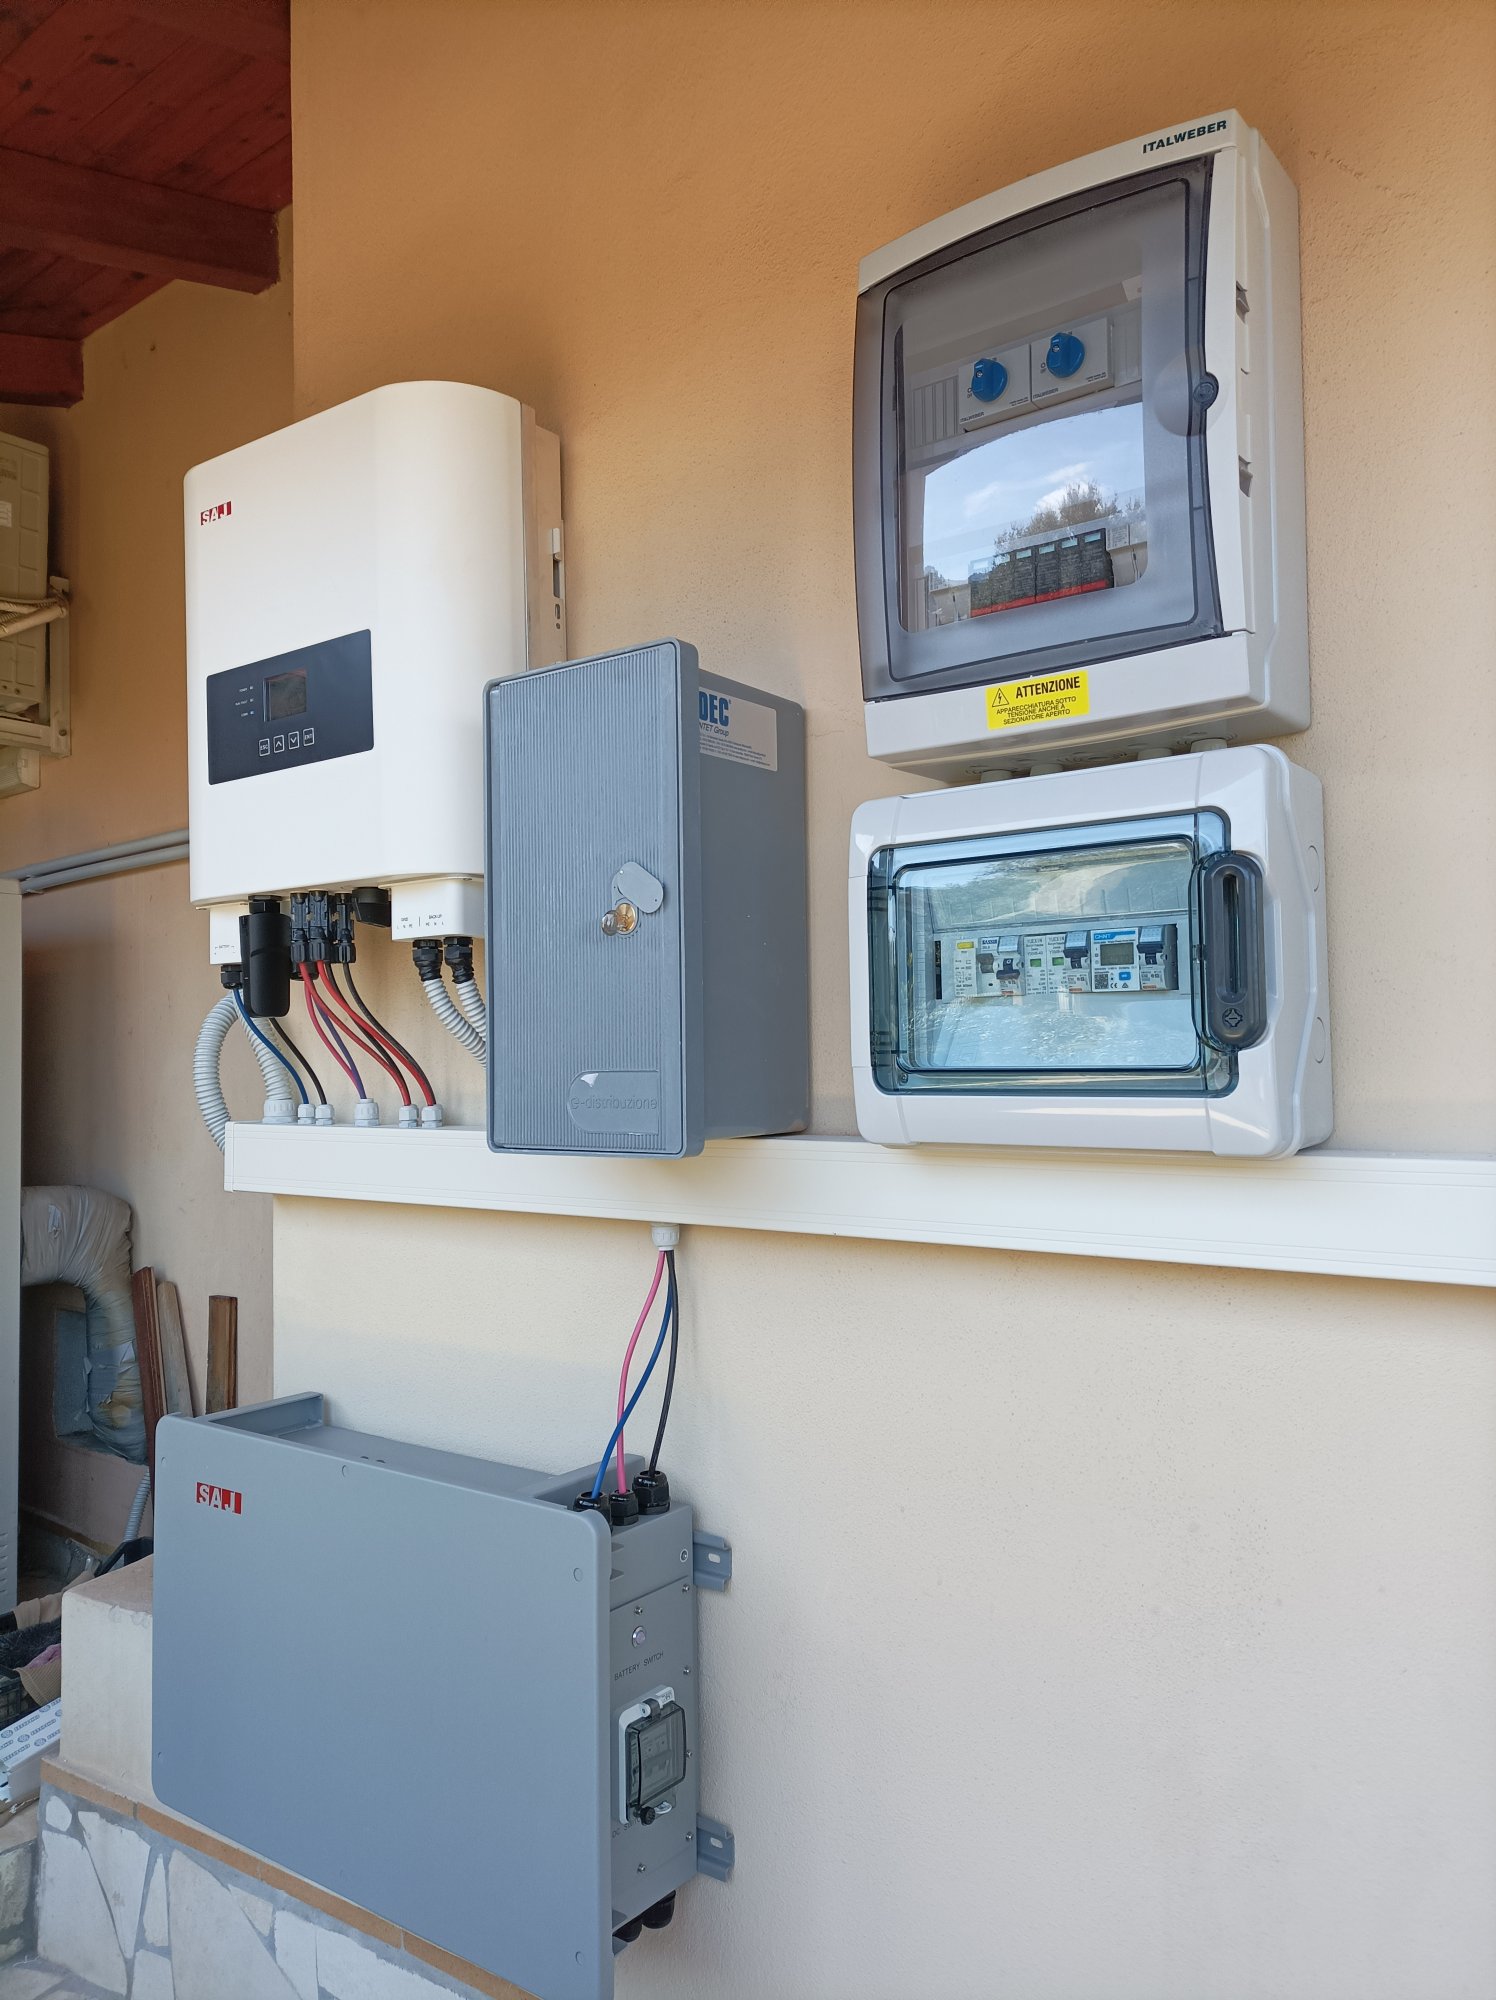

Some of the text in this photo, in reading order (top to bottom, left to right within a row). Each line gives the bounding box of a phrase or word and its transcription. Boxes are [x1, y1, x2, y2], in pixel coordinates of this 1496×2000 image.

[1143, 120, 1227, 154] ITALWEBER
[200, 501, 232, 526] SAJ
[1016, 676, 1080, 699] ATTENZIONE
[996, 696, 1077, 715] APPARECCHIATURA SOTTO
[1003, 709, 1071, 725] SEZIONATORE APERTO
[1007, 708, 1038, 718] TENSIONE
[1039, 704, 1059, 713] ANCHE
[713, 726, 730, 737] Group
[196, 1481, 242, 1515] SAJ
[614, 1651, 664, 1680] BATTERY SWITCH
